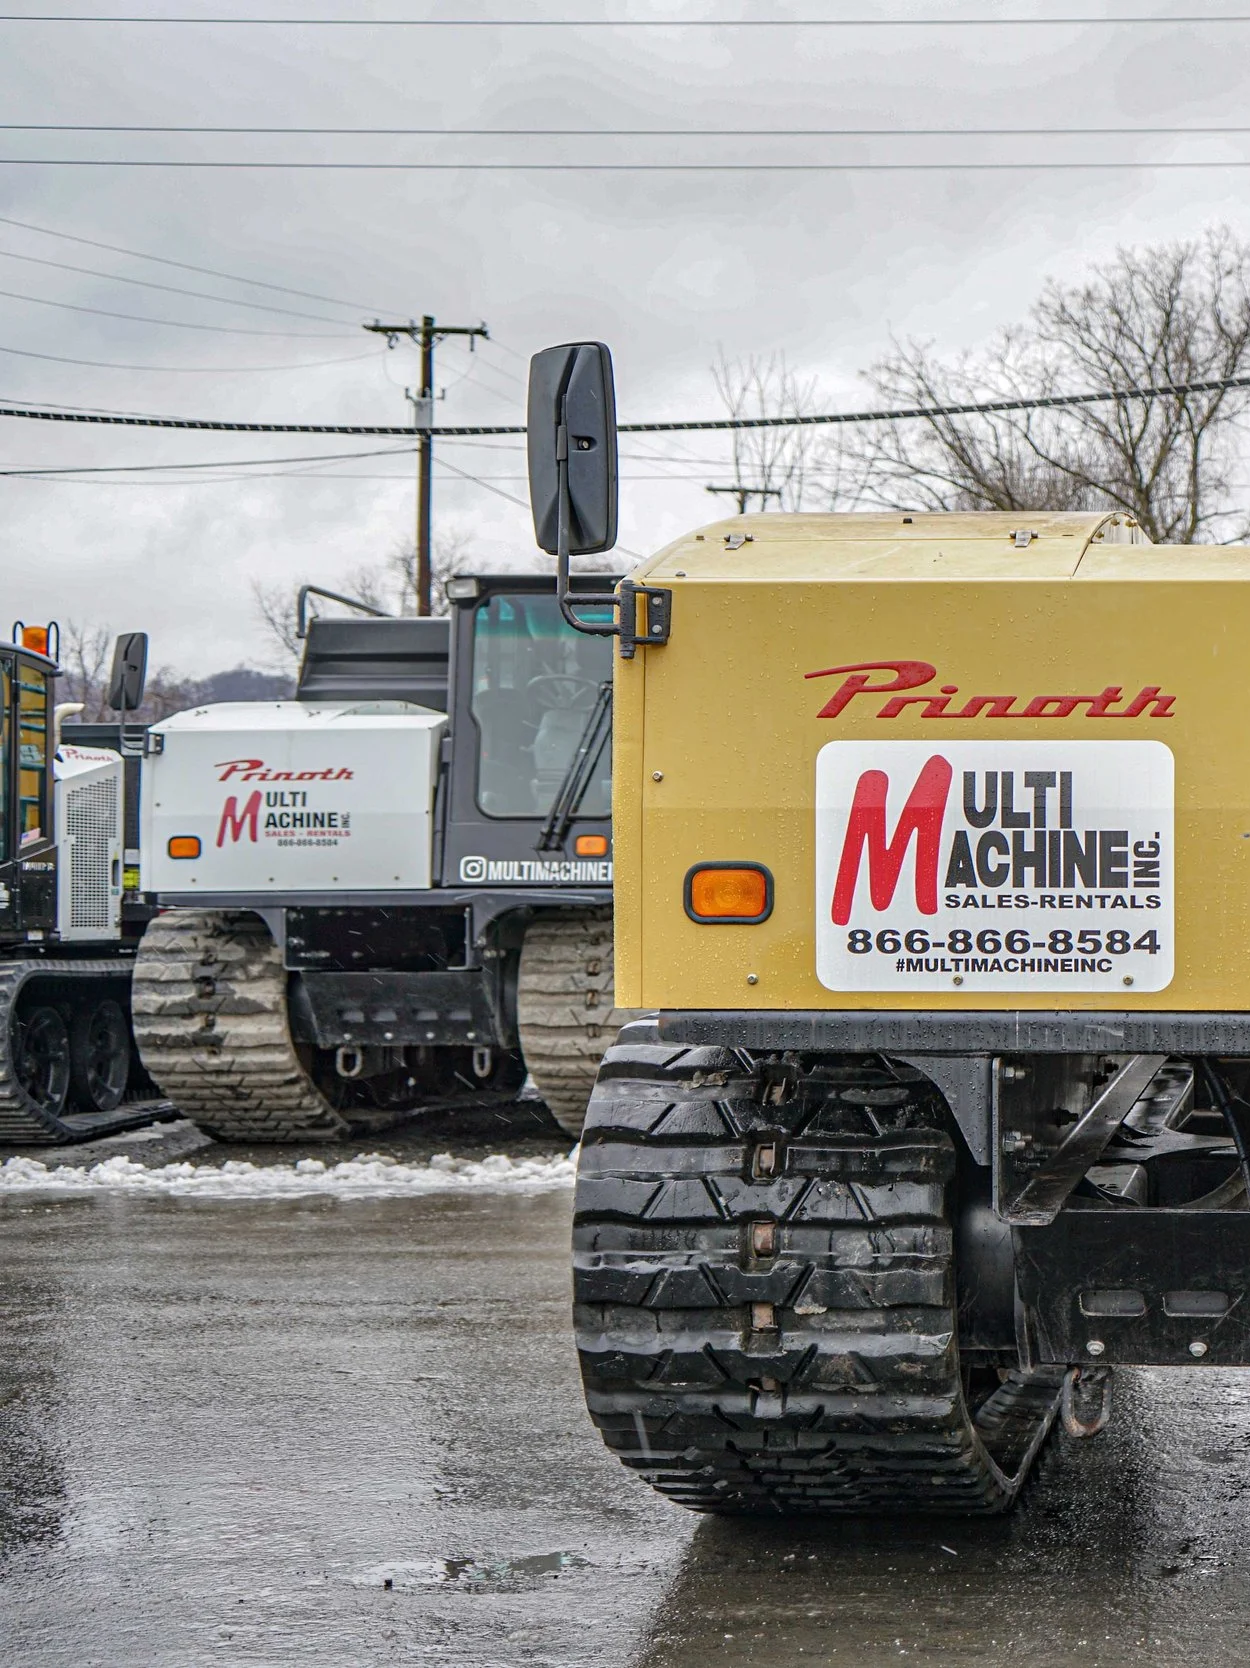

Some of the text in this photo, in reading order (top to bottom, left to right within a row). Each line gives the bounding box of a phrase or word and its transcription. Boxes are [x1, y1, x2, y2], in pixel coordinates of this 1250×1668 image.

[804, 660, 1176, 718] Prinoth
[214, 759, 354, 782] Prinoth
[1133, 832, 1160, 888] INC.
[945, 894, 1162, 909] SALES-RENTALS
[846, 929, 1161, 955] 866-866-8584
[896, 958, 1113, 973] #MULTIMACHINEINC
